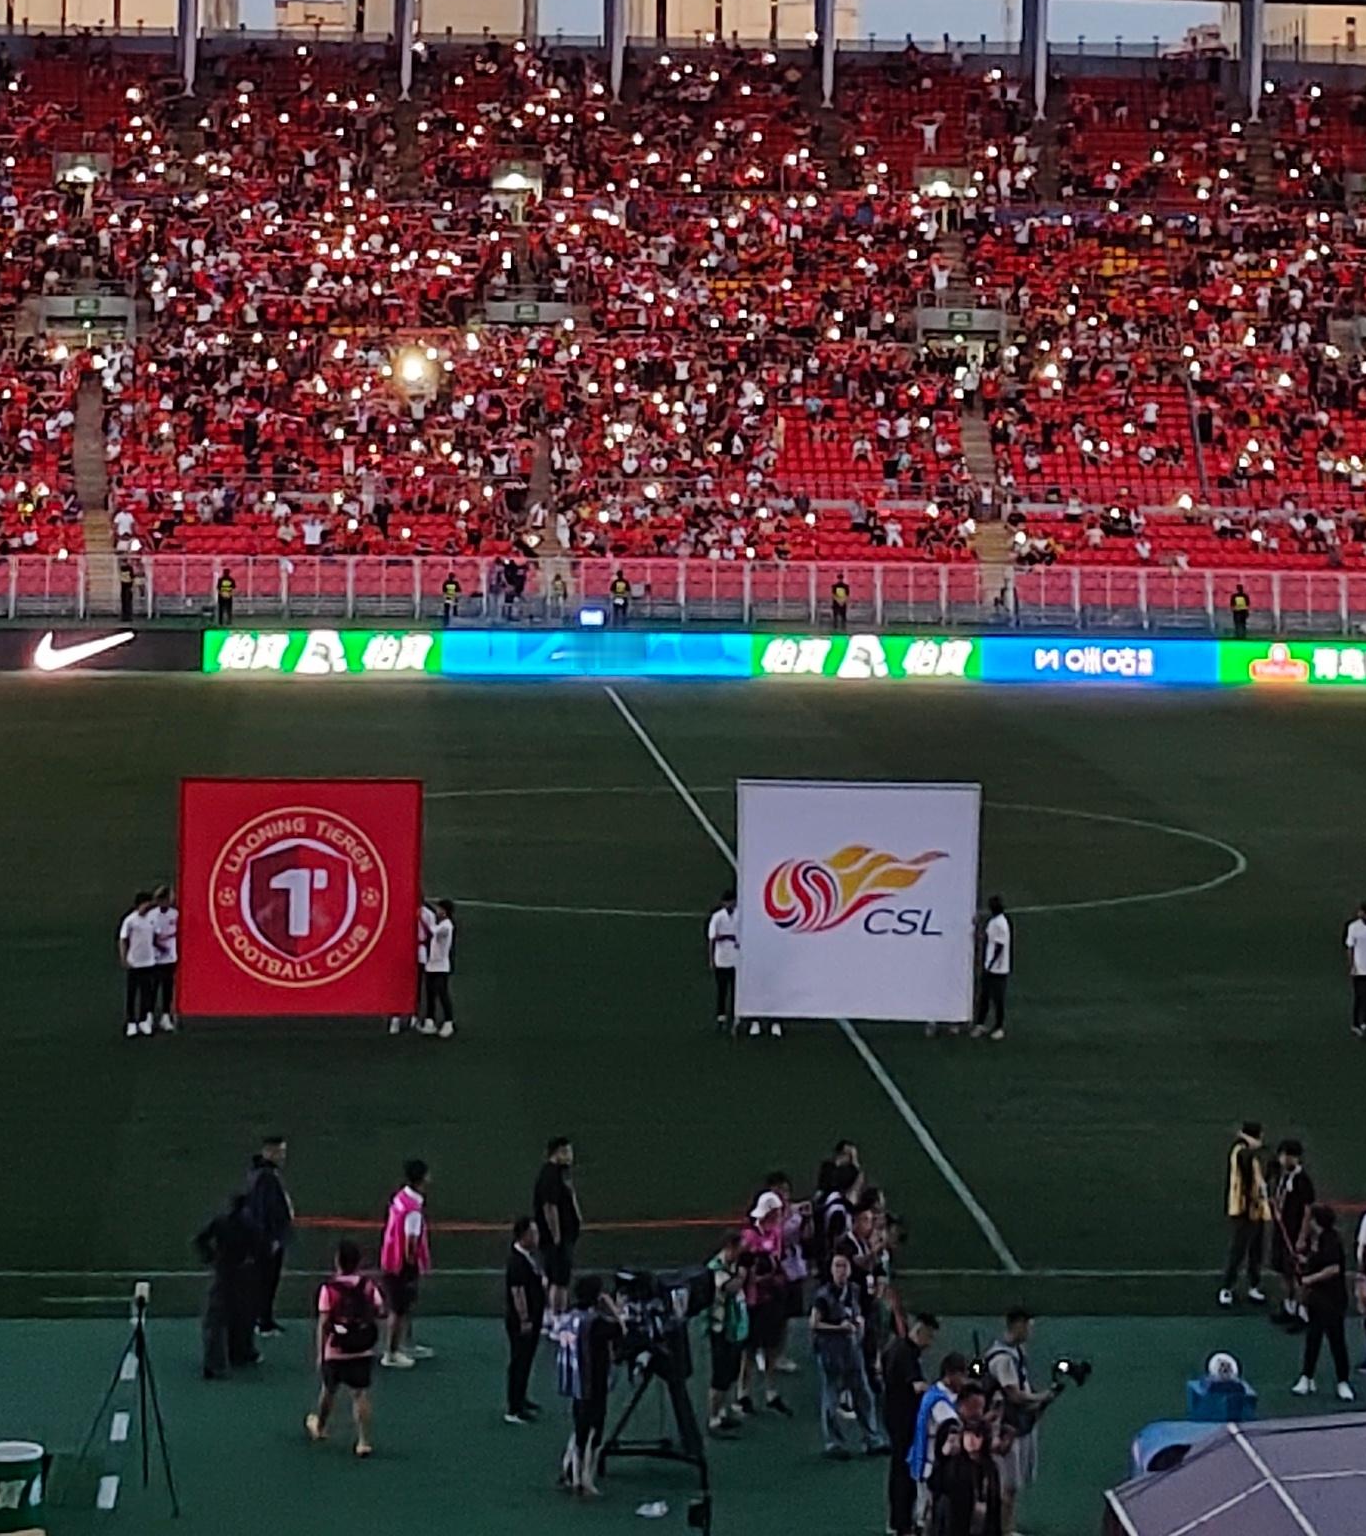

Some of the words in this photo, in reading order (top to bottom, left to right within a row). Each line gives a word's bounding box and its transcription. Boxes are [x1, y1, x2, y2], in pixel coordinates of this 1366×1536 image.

[224, 817, 306, 873] LIAONING
[316, 820, 374, 873] TIEREN
[863, 909, 943, 936] CSL
[225, 924, 319, 979] FOOTBALL
[326, 924, 370, 968] CLUB
